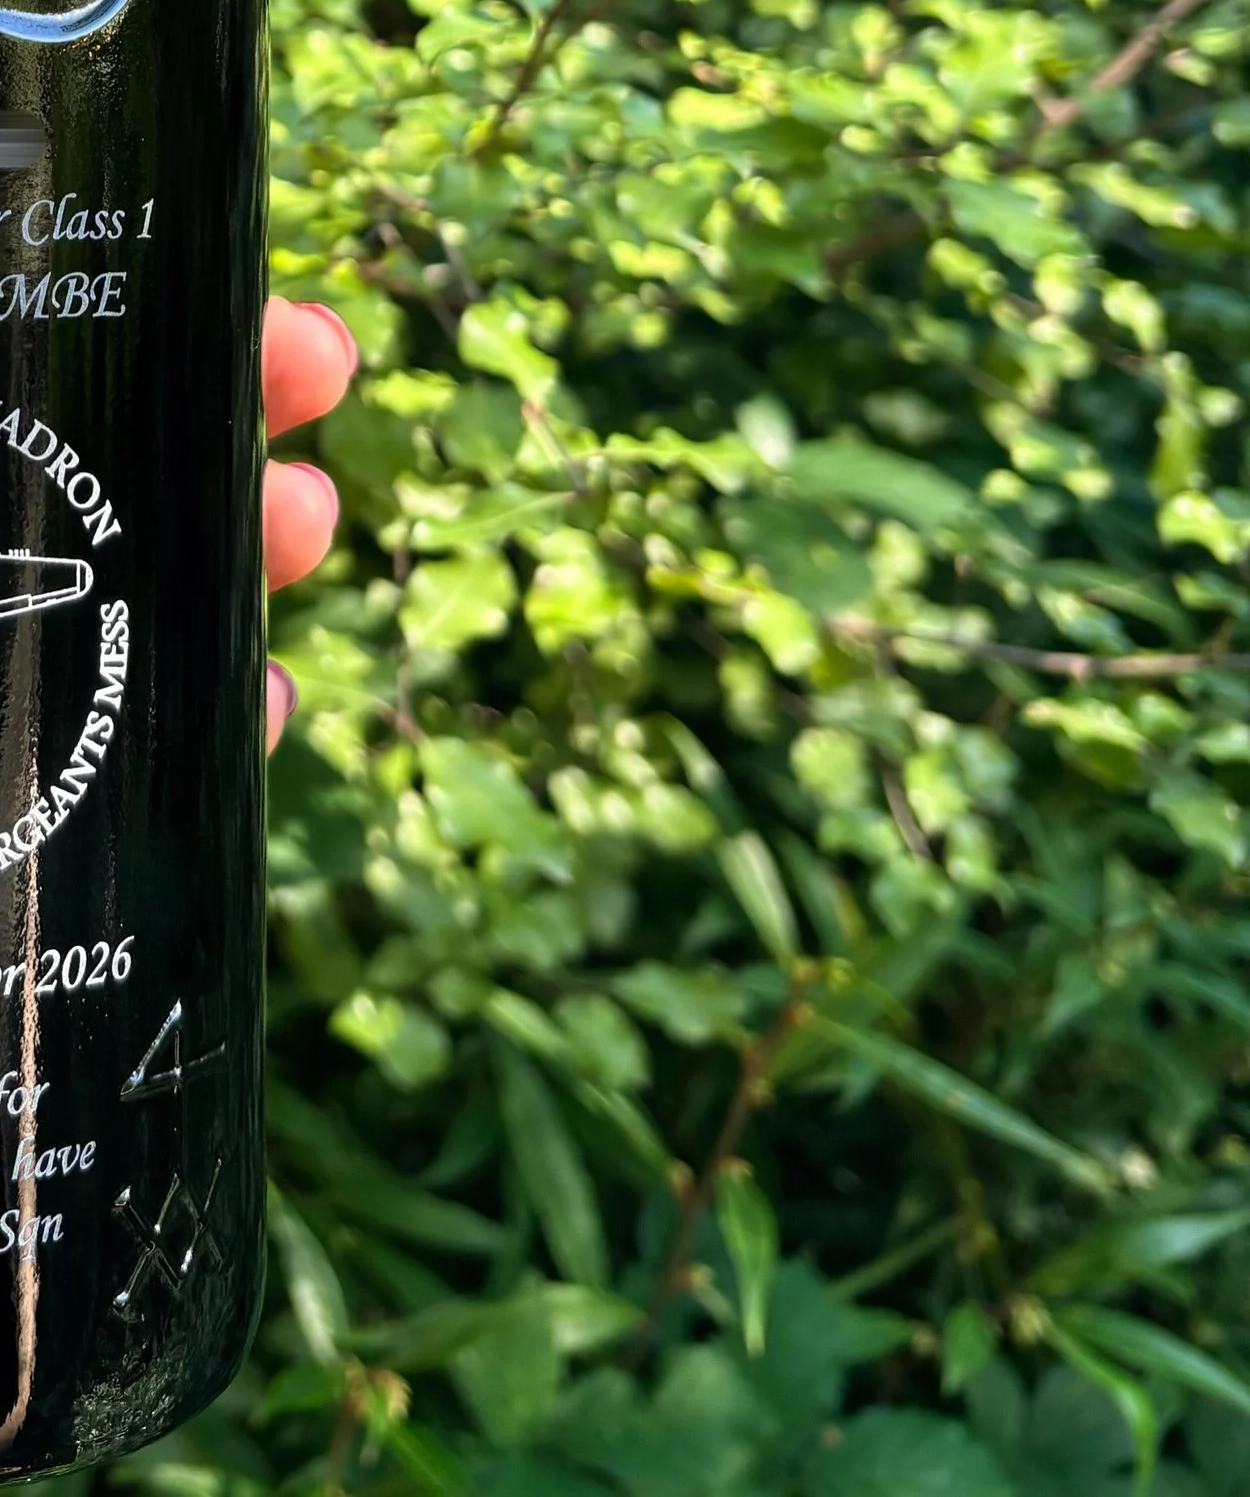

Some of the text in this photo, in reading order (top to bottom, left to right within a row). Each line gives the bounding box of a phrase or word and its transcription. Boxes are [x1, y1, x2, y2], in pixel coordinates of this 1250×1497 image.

[21, 192, 126, 246] Class
[135, 197, 156, 240] 1
[94, 599, 130, 712] MESS
[33, 935, 136, 996] 2026
[11, 1134, 97, 1182] have
